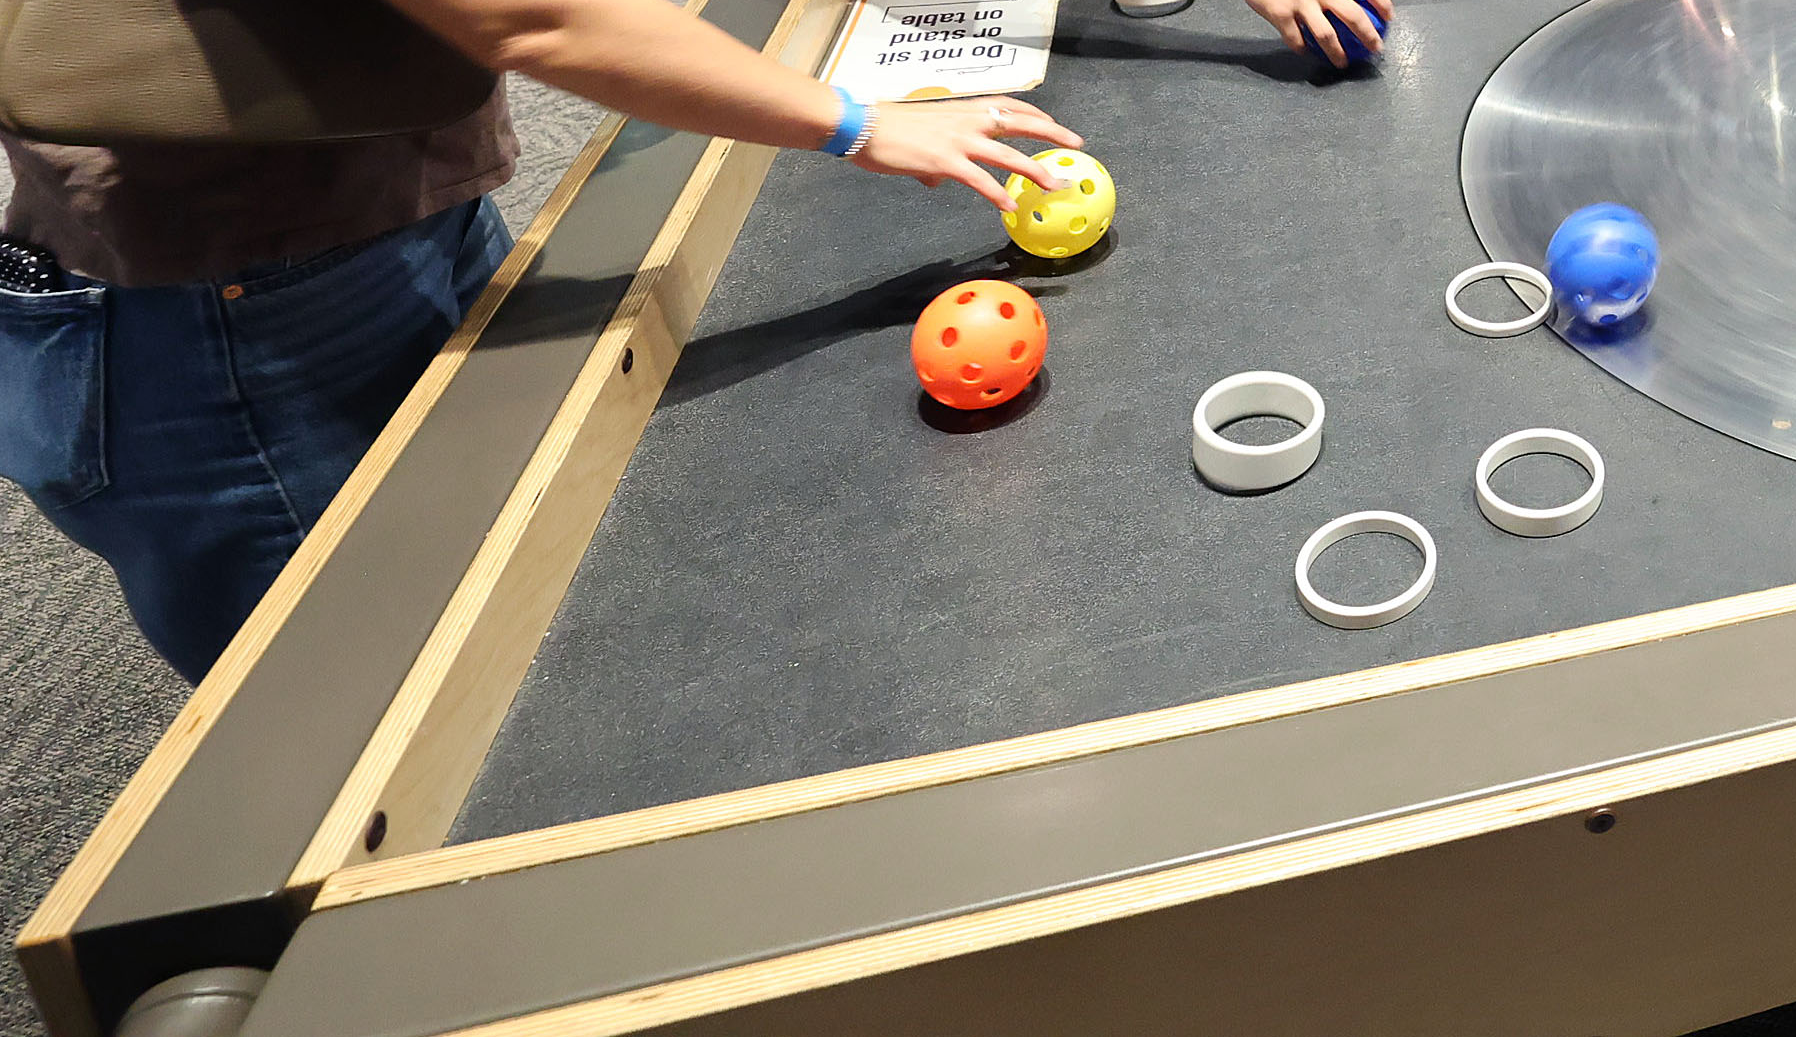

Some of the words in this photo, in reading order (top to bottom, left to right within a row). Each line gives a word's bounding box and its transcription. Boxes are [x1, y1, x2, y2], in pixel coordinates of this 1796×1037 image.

[901, 11, 966, 27] table
[973, 9, 1004, 21] on
[889, 28, 967, 47] stand
[972, 26, 1002, 39] or
[874, 50, 912, 66] sit
[918, 47, 964, 62] not
[971, 44, 1004, 59] Do
